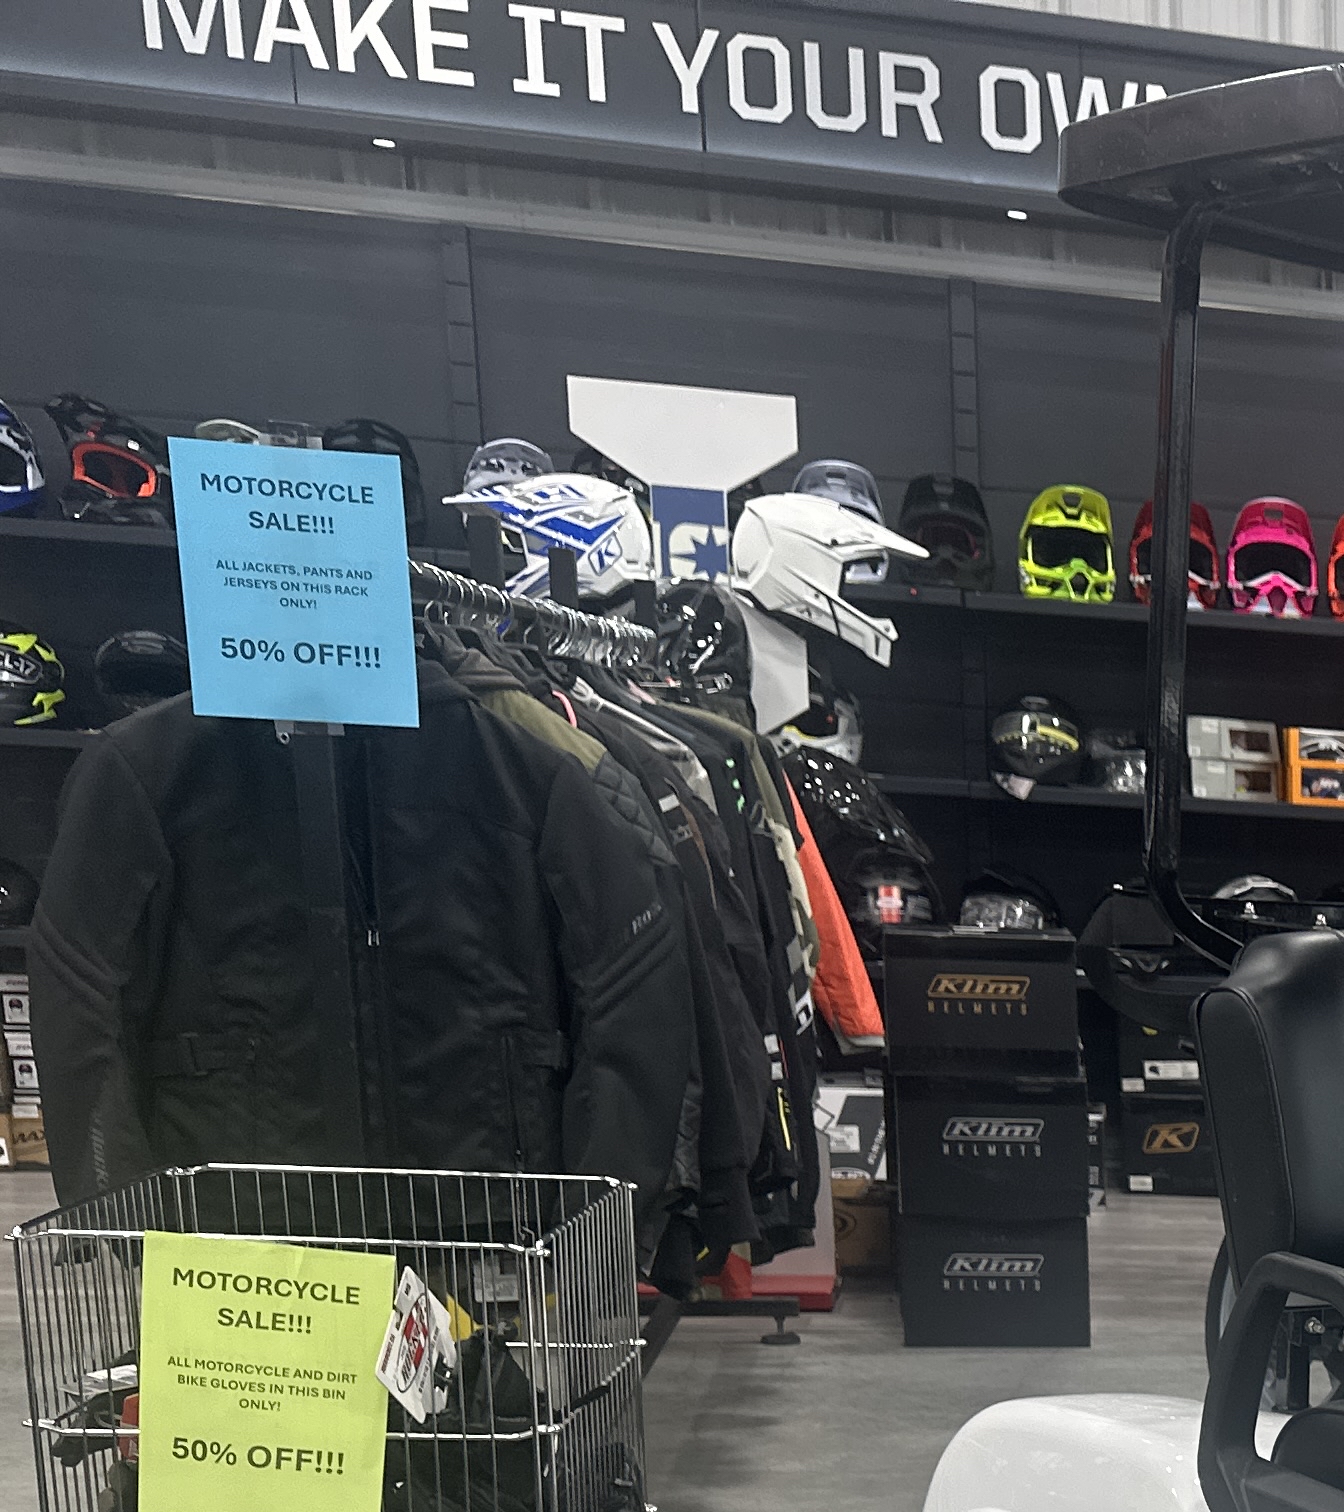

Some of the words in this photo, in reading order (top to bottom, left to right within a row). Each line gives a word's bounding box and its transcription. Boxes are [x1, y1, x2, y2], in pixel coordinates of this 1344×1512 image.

[508, 4, 626, 102] IT
[651, 21, 943, 144] YOUR
[978, 64, 1169, 154] OW
[200, 473, 374, 505] MOTORCYCLE
[248, 511, 335, 534] SALE!!!
[215, 559, 239, 571] ALL
[241, 561, 300, 576] JACKETS,
[303, 566, 343, 579] PANTS
[346, 570, 373, 581] AND
[223, 576, 278, 590] JERSEYS
[280, 581, 300, 593] ON
[302, 582, 332, 594] THIS
[334, 585, 369, 597] RACK
[279, 597, 318, 609] ONLY!
[0, 649, 37, 676] L-17
[220, 637, 285, 662] 50%
[293, 642, 381, 668] OFF!!!
[173, 1267, 361, 1305] MOTORCYCLE
[217, 1308, 312, 1334] SALE!!!
[167, 1356, 191, 1368] ALL
[194, 1359, 290, 1378] MOTORCYCLE
[293, 1368, 323, 1381] AND
[326, 1371, 358, 1384] DIRT
[177, 1374, 207, 1387] BIKE
[210, 1378, 265, 1393] GLOVES
[269, 1383, 284, 1394] IN
[288, 1385, 319, 1398] THIS
[322, 1388, 346, 1400] BIN
[238, 1398, 281, 1411] ONLY!
[172, 1436, 237, 1466] 50%
[247, 1445, 344, 1475] OFF!!!
